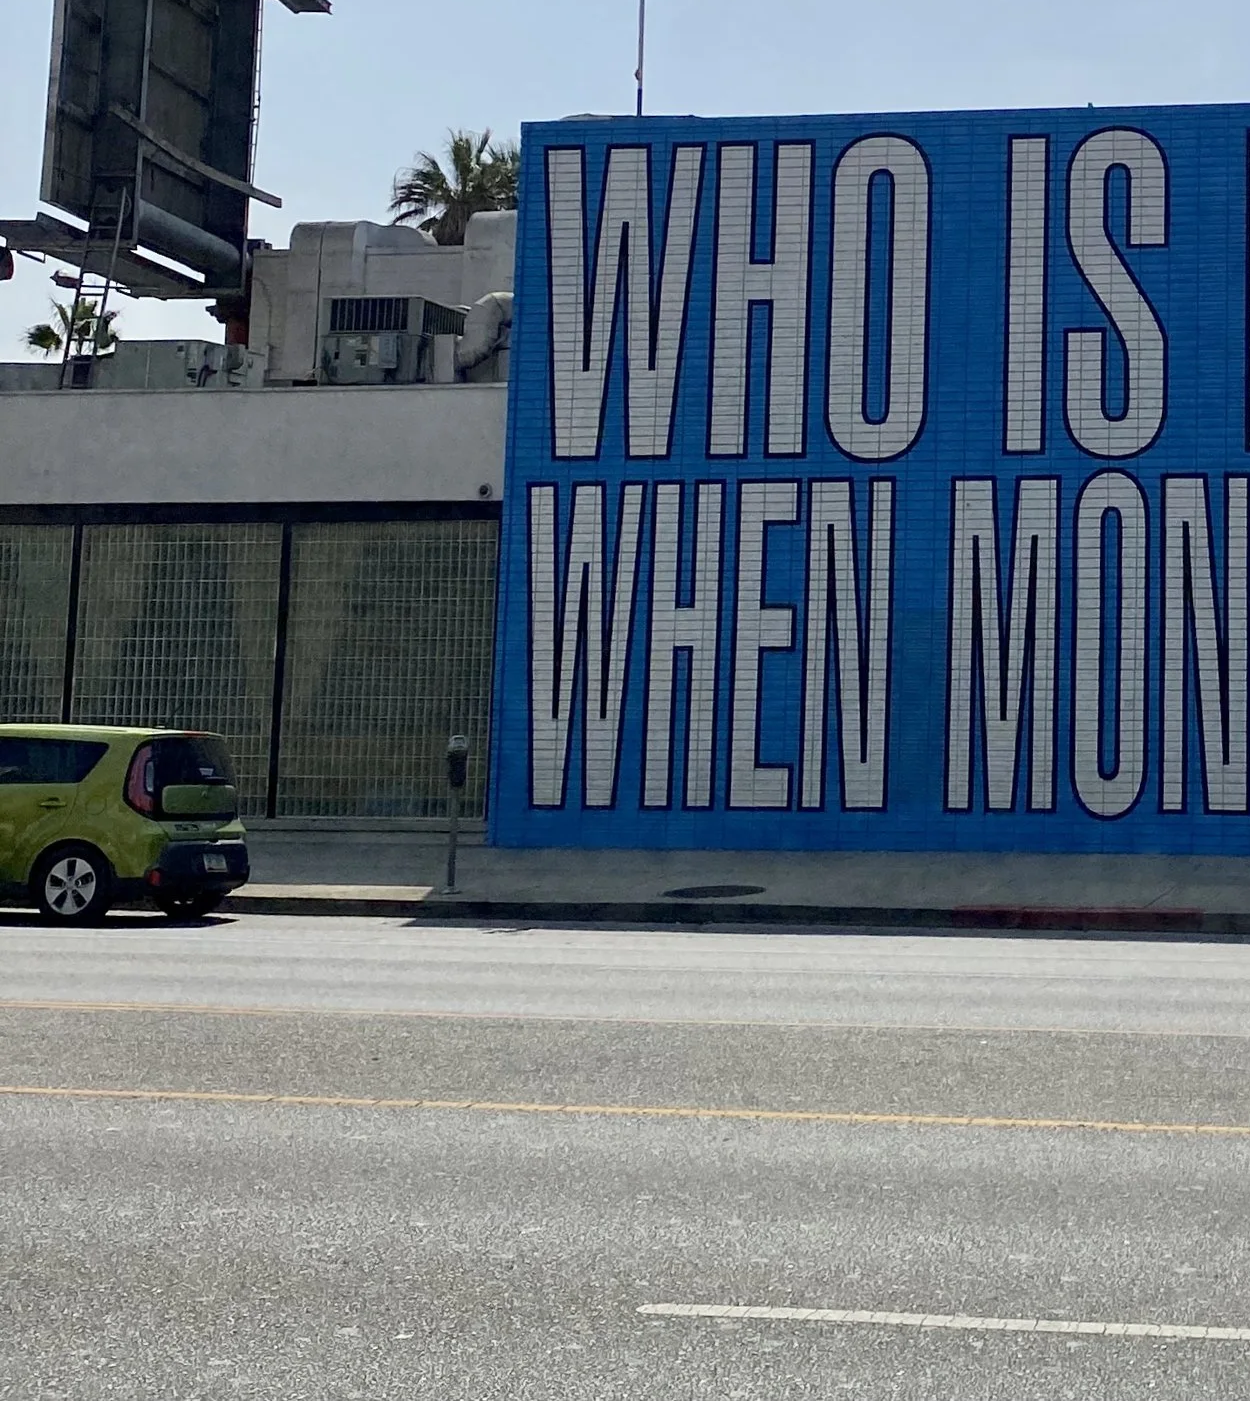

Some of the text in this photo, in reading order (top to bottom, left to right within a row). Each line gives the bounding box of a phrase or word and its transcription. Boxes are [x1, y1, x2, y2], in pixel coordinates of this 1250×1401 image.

[544, 132, 933, 463] WHO
[1001, 125, 1169, 460] IS
[526, 477, 897, 812] WHEN
